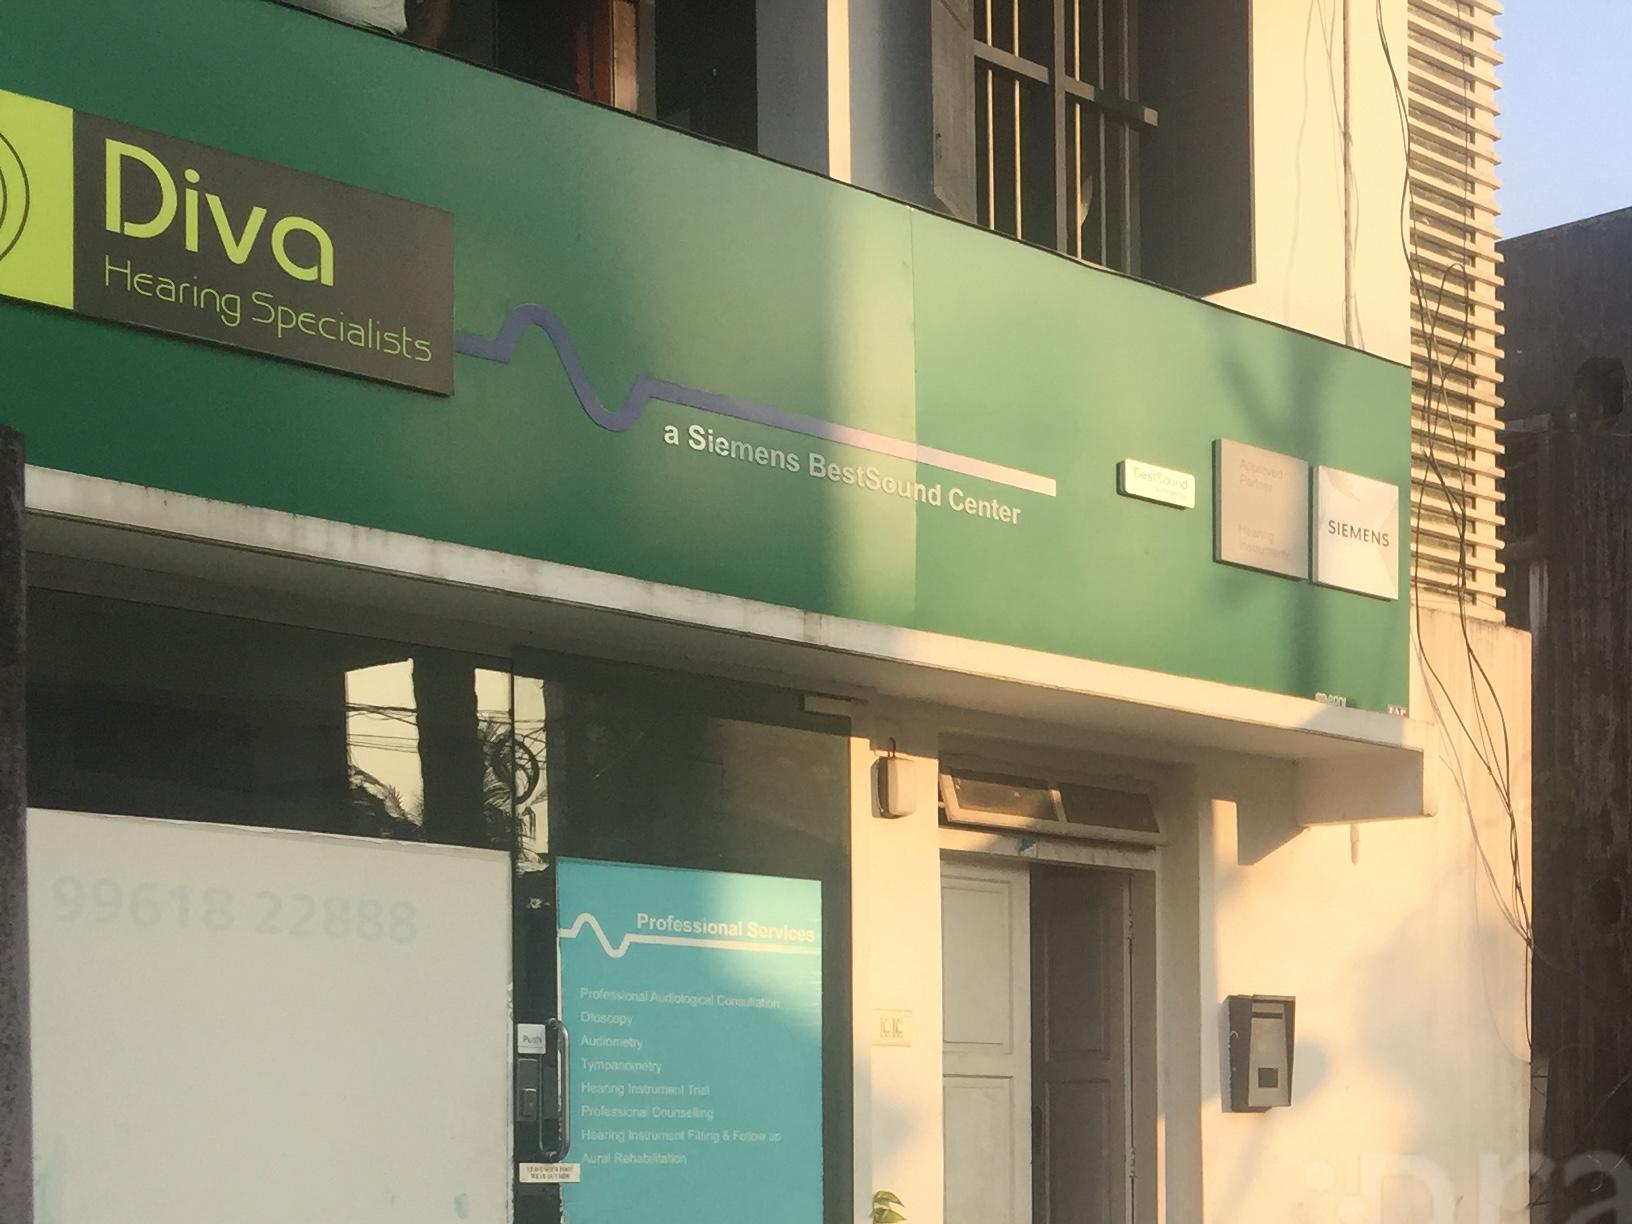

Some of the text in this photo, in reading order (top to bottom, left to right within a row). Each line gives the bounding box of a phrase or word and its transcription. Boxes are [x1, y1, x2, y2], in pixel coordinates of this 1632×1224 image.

[105, 138, 334, 287] Diva
[105, 254, 432, 362] Hearing Specialists
[664, 424, 1021, 524] a Siemens BestSound Center
[1328, 519, 1390, 548] SIEMENS
[51, 874, 419, 946] 99618 22888
[637, 913, 816, 942] Professional Services
[580, 987, 648, 1002] Professional
[580, 1035, 643, 1050] Audiometry
[580, 1082, 624, 1097] Hearing
[628, 1084, 684, 1096] Instrument
[580, 1105, 714, 1121] Professional Counselling
[581, 1129, 625, 1143] Hearing
[628, 1129, 684, 1142] Instrument
